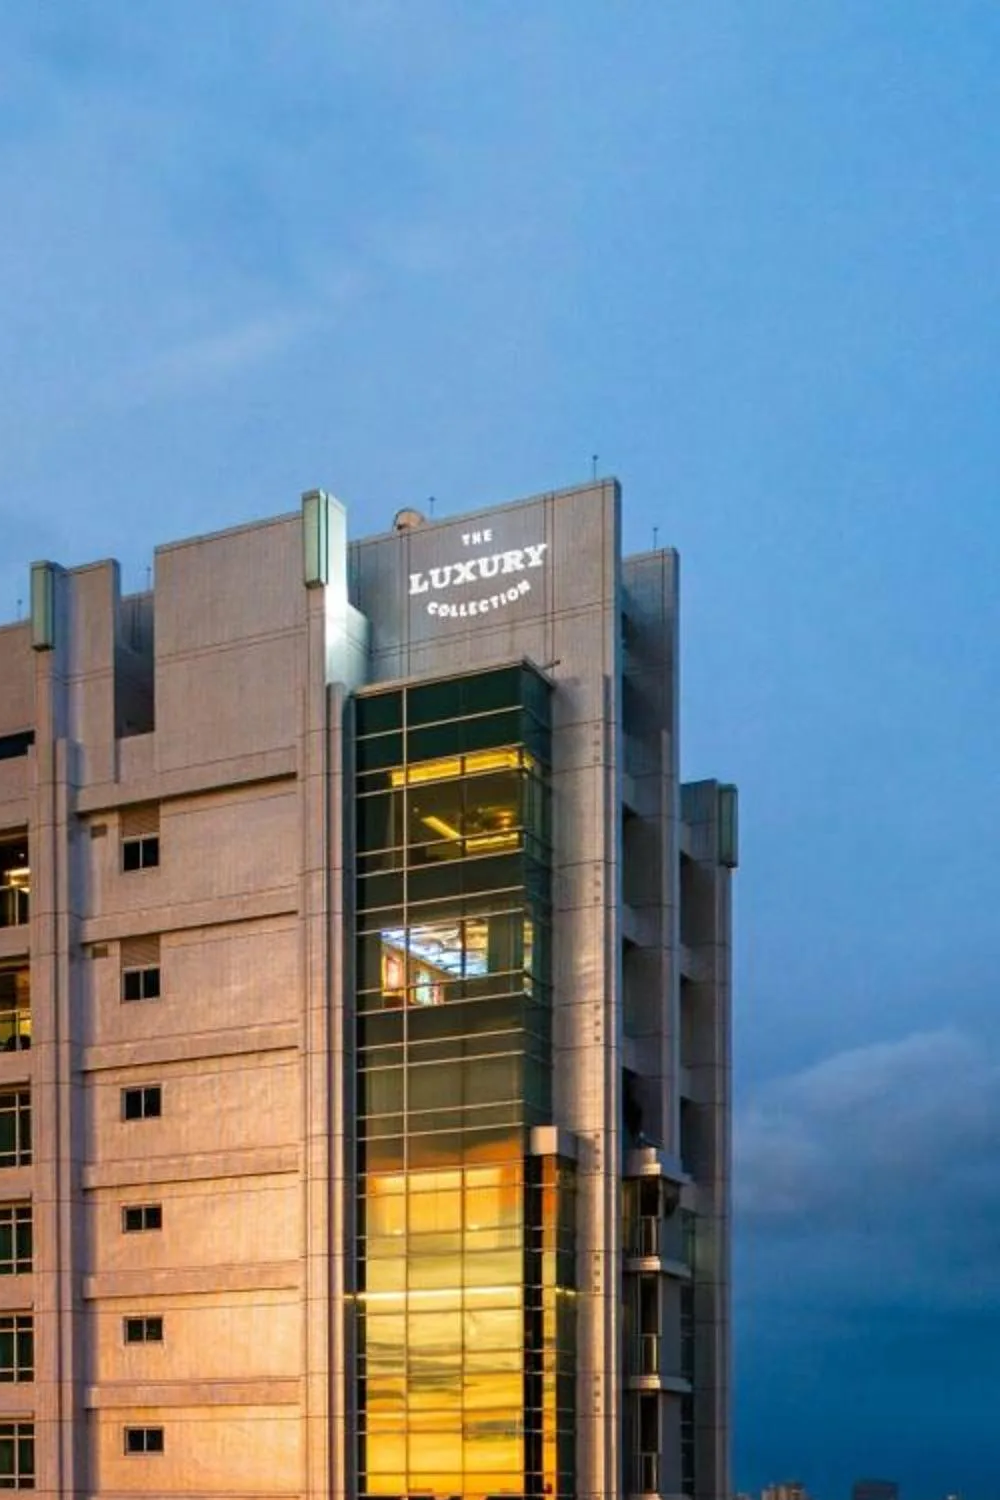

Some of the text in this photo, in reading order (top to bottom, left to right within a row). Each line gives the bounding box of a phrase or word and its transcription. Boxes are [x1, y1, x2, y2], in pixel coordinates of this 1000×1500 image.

[461, 529, 493, 546] THE
[409, 543, 548, 595] LUXURY
[427, 579, 531, 618] COLLECTION
